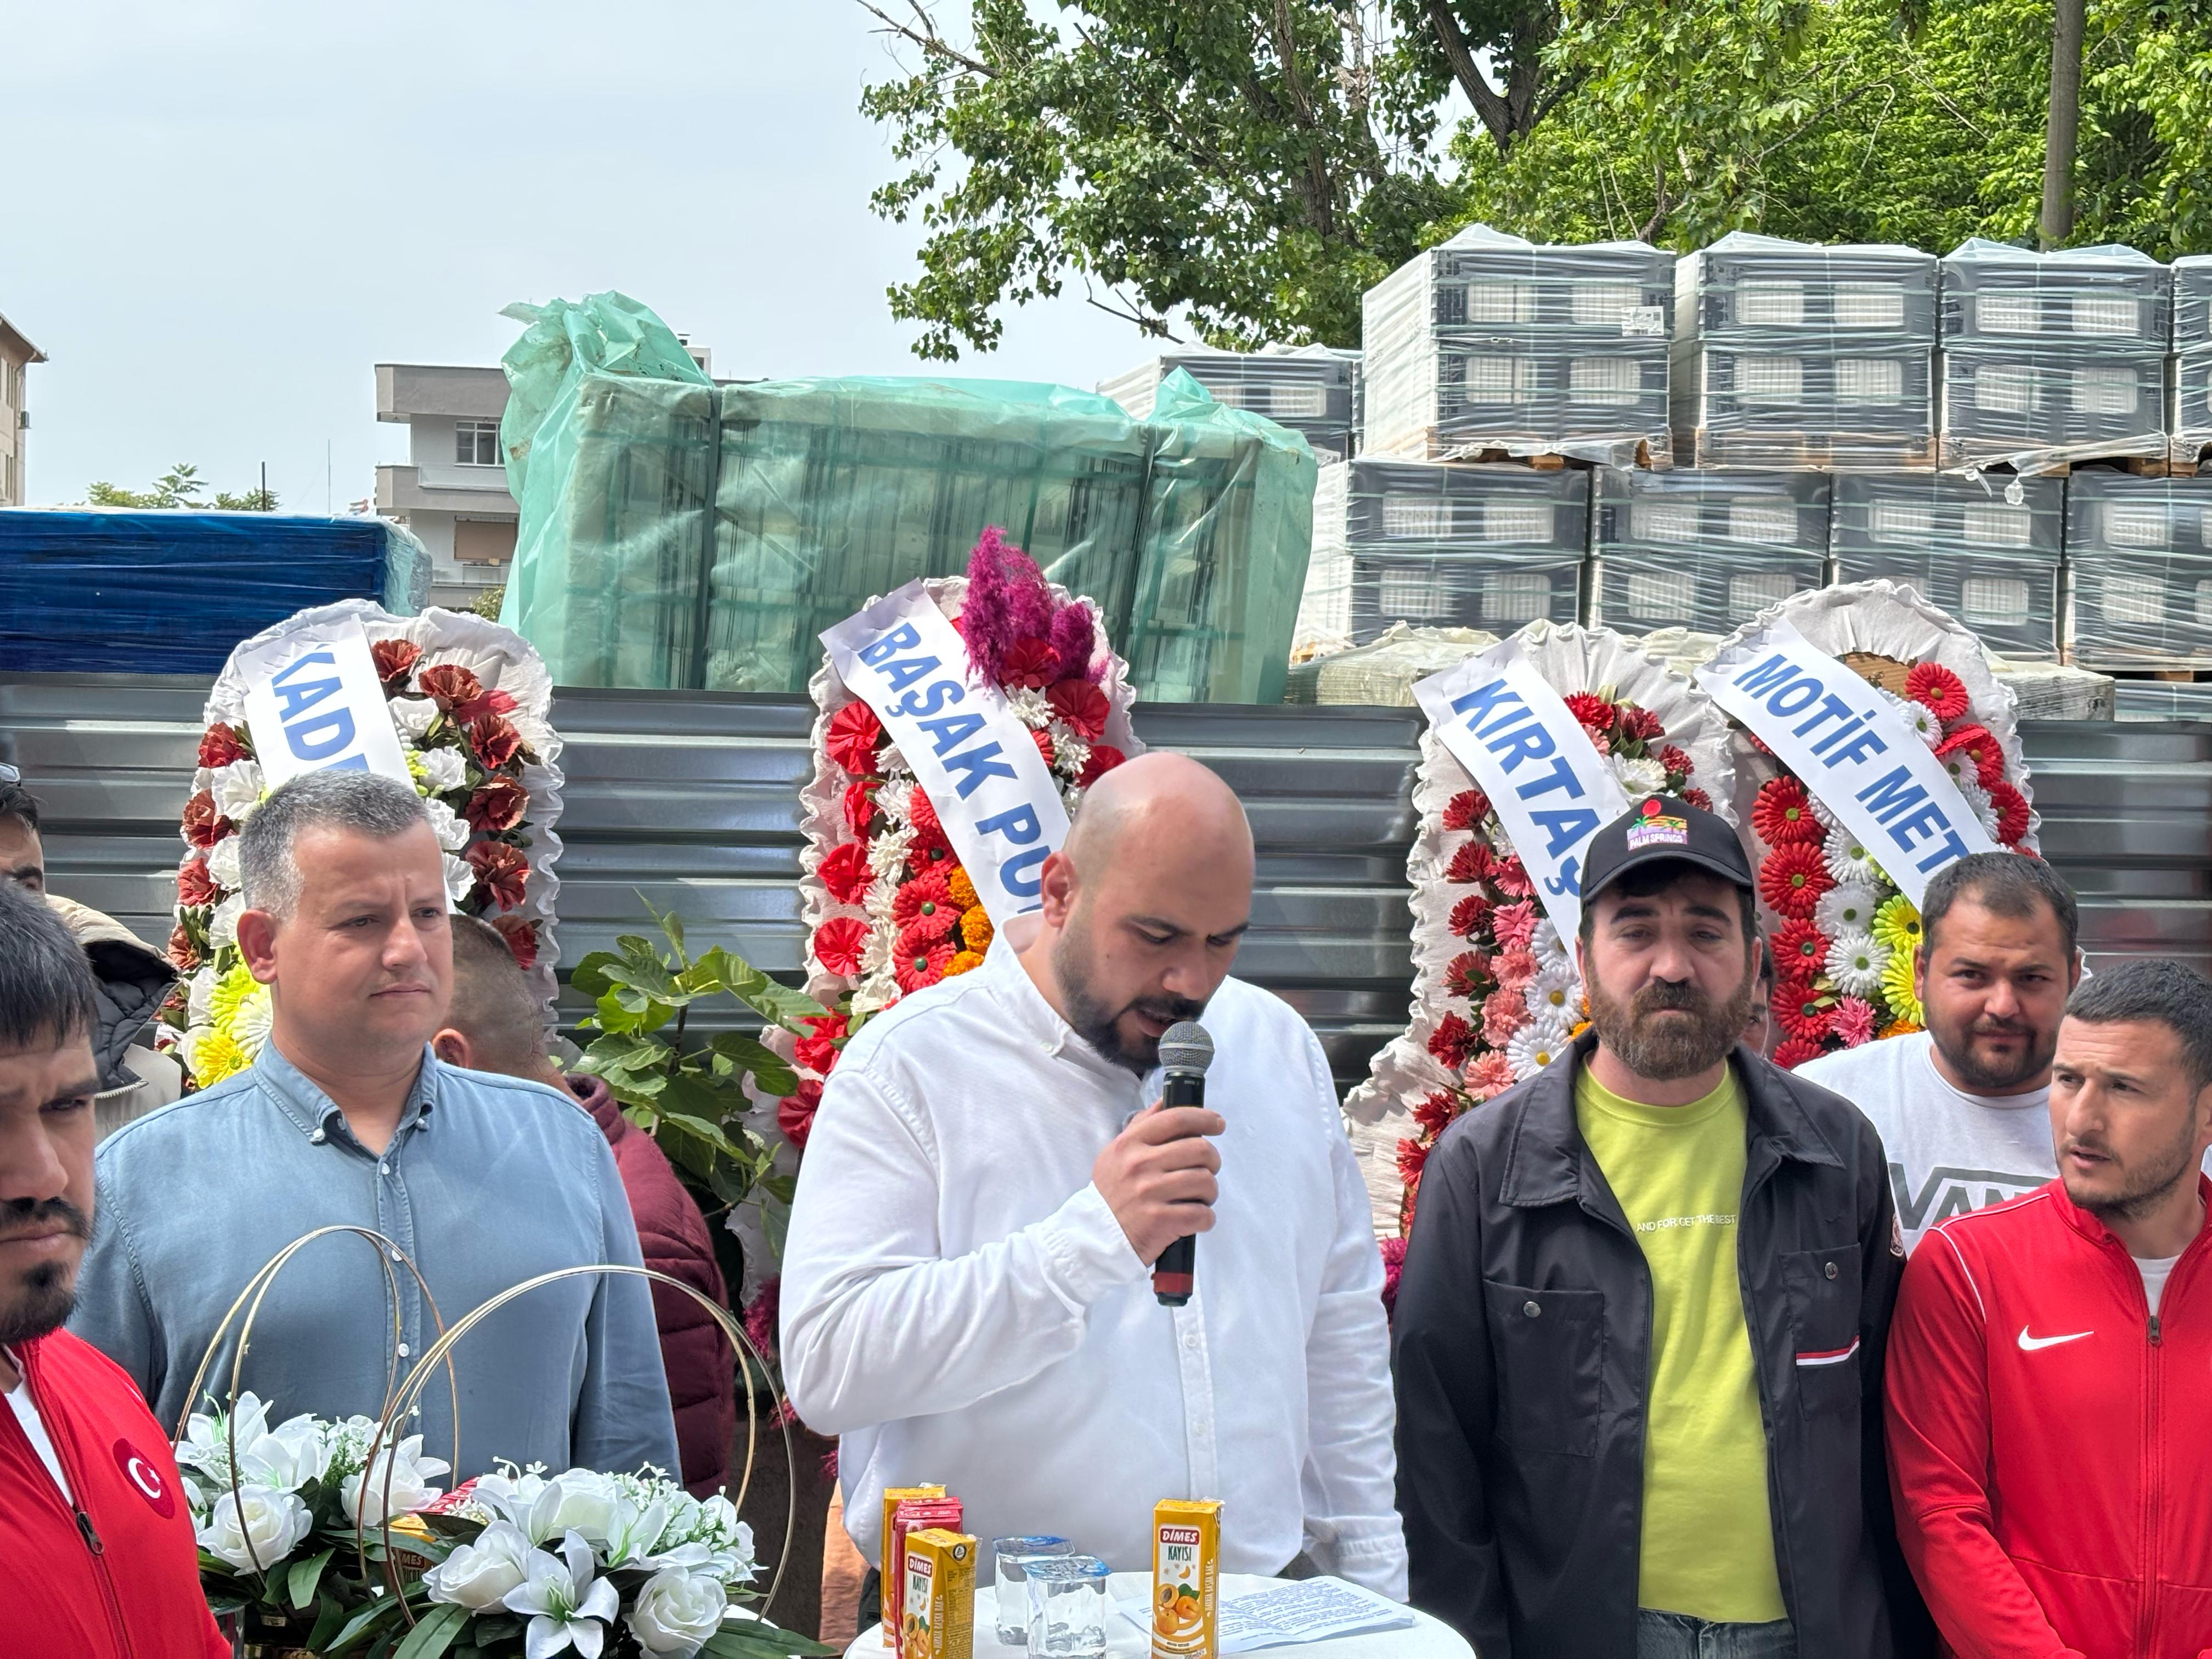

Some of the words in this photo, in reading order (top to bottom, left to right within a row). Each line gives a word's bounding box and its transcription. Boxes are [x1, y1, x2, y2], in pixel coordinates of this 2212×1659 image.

[271, 643, 371, 773] KAD
[1732, 653, 1889, 769] MOTİF
[857, 622, 1018, 802] BAŞAK
[975, 802, 1050, 914] PU
[1628, 834, 1650, 849] PALM
[1650, 833, 1683, 843] SPRINGS
[1636, 1221, 1656, 1232] AND
[1657, 1217, 1678, 1230] FOR
[1679, 1216, 1695, 1227] GET
[1696, 1214, 1715, 1224] THE
[1715, 1215, 1736, 1224] BEST
[402, 1553, 422, 1566] MES
[1167, 1545, 1192, 1561] KAYISI
[912, 1575, 928, 1594] KAYISI
